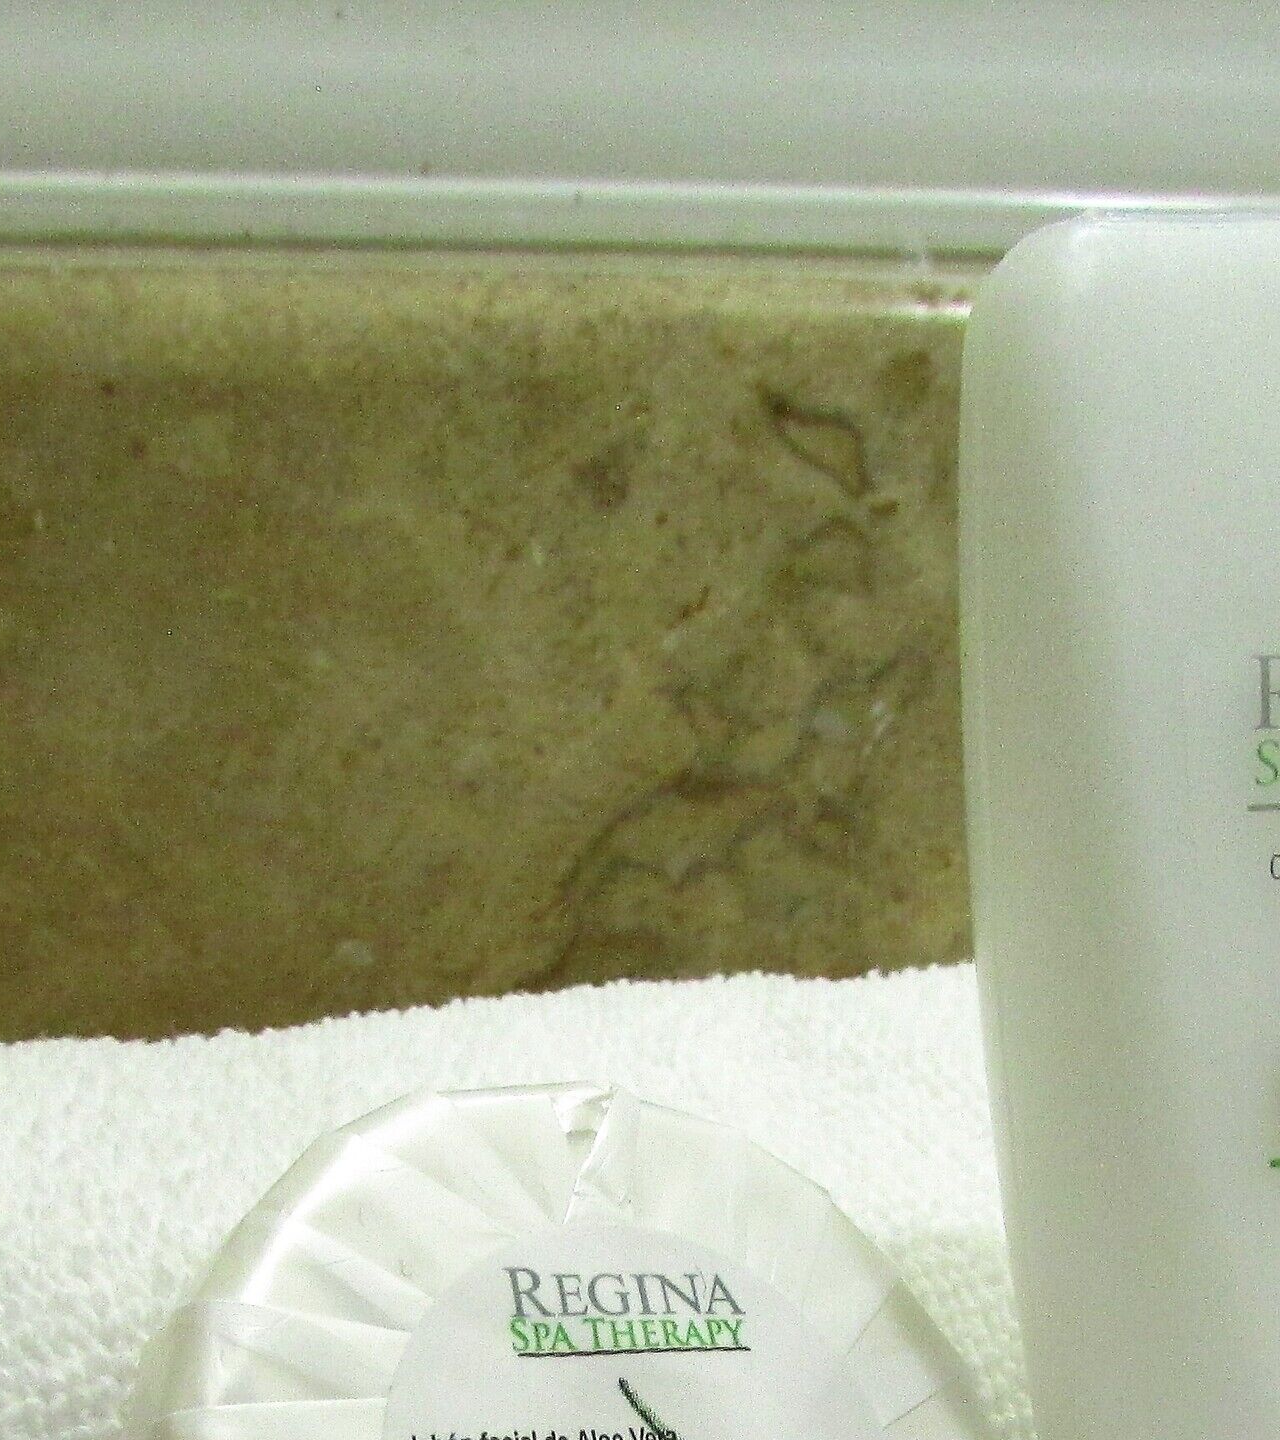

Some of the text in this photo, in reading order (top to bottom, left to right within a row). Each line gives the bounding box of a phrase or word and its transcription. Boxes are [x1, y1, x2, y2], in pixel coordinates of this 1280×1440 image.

[502, 1266, 746, 1318] REGINA
[508, 1315, 746, 1353] SPA THERAPY
